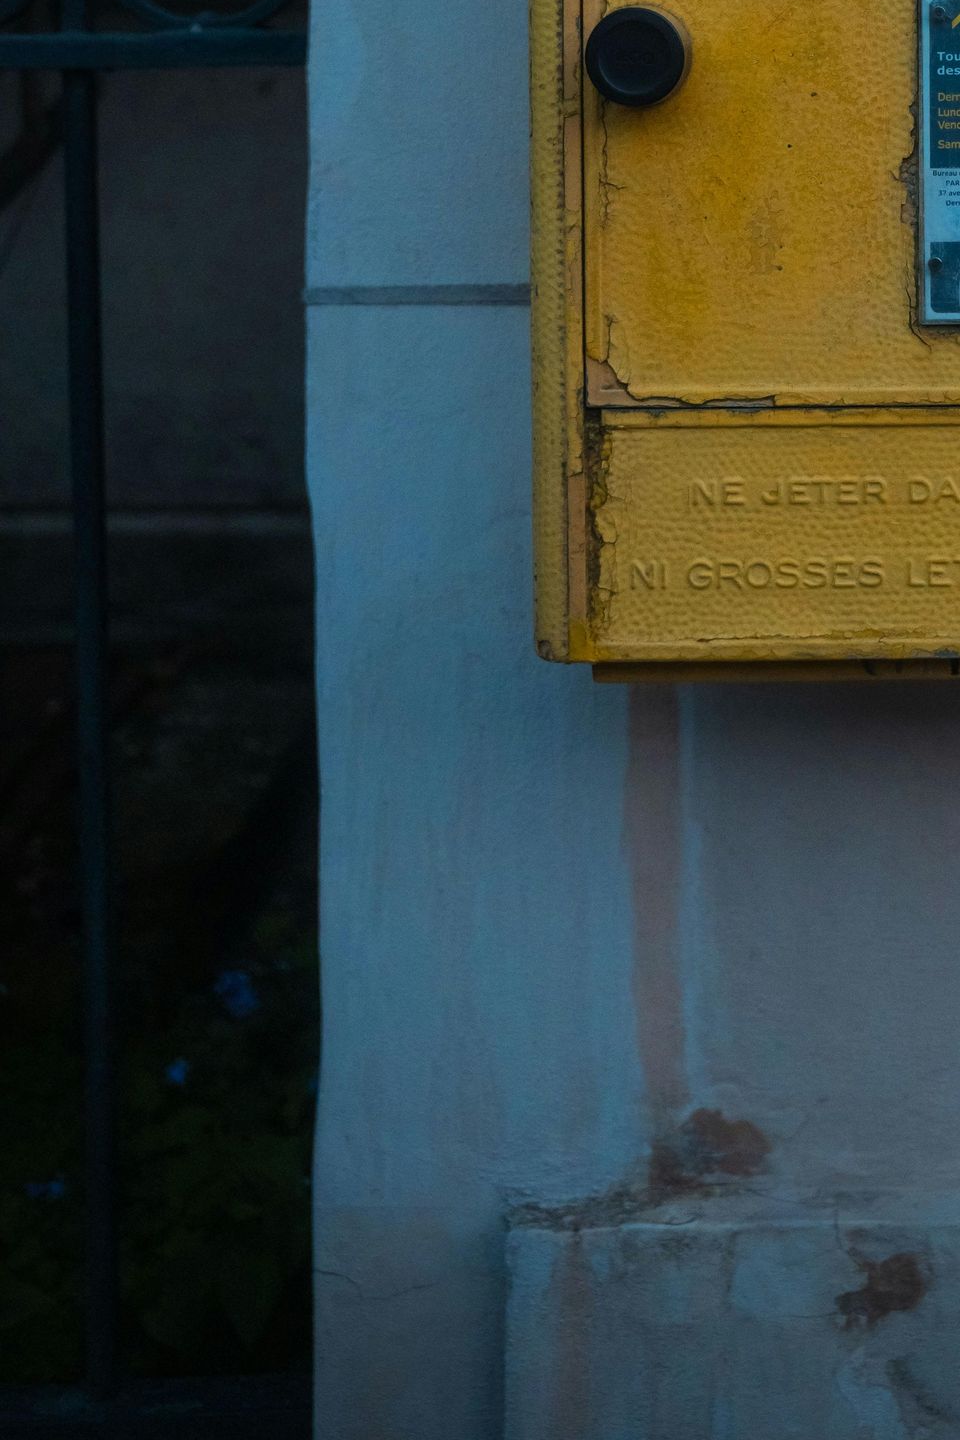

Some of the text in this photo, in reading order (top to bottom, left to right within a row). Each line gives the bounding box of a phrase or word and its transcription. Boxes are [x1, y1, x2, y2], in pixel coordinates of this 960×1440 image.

[932, 169, 957, 177] Bureau
[689, 475, 745, 506] NE
[760, 474, 888, 506] JETER
[628, 558, 670, 590] NI
[687, 556, 885, 590] GROSSES
